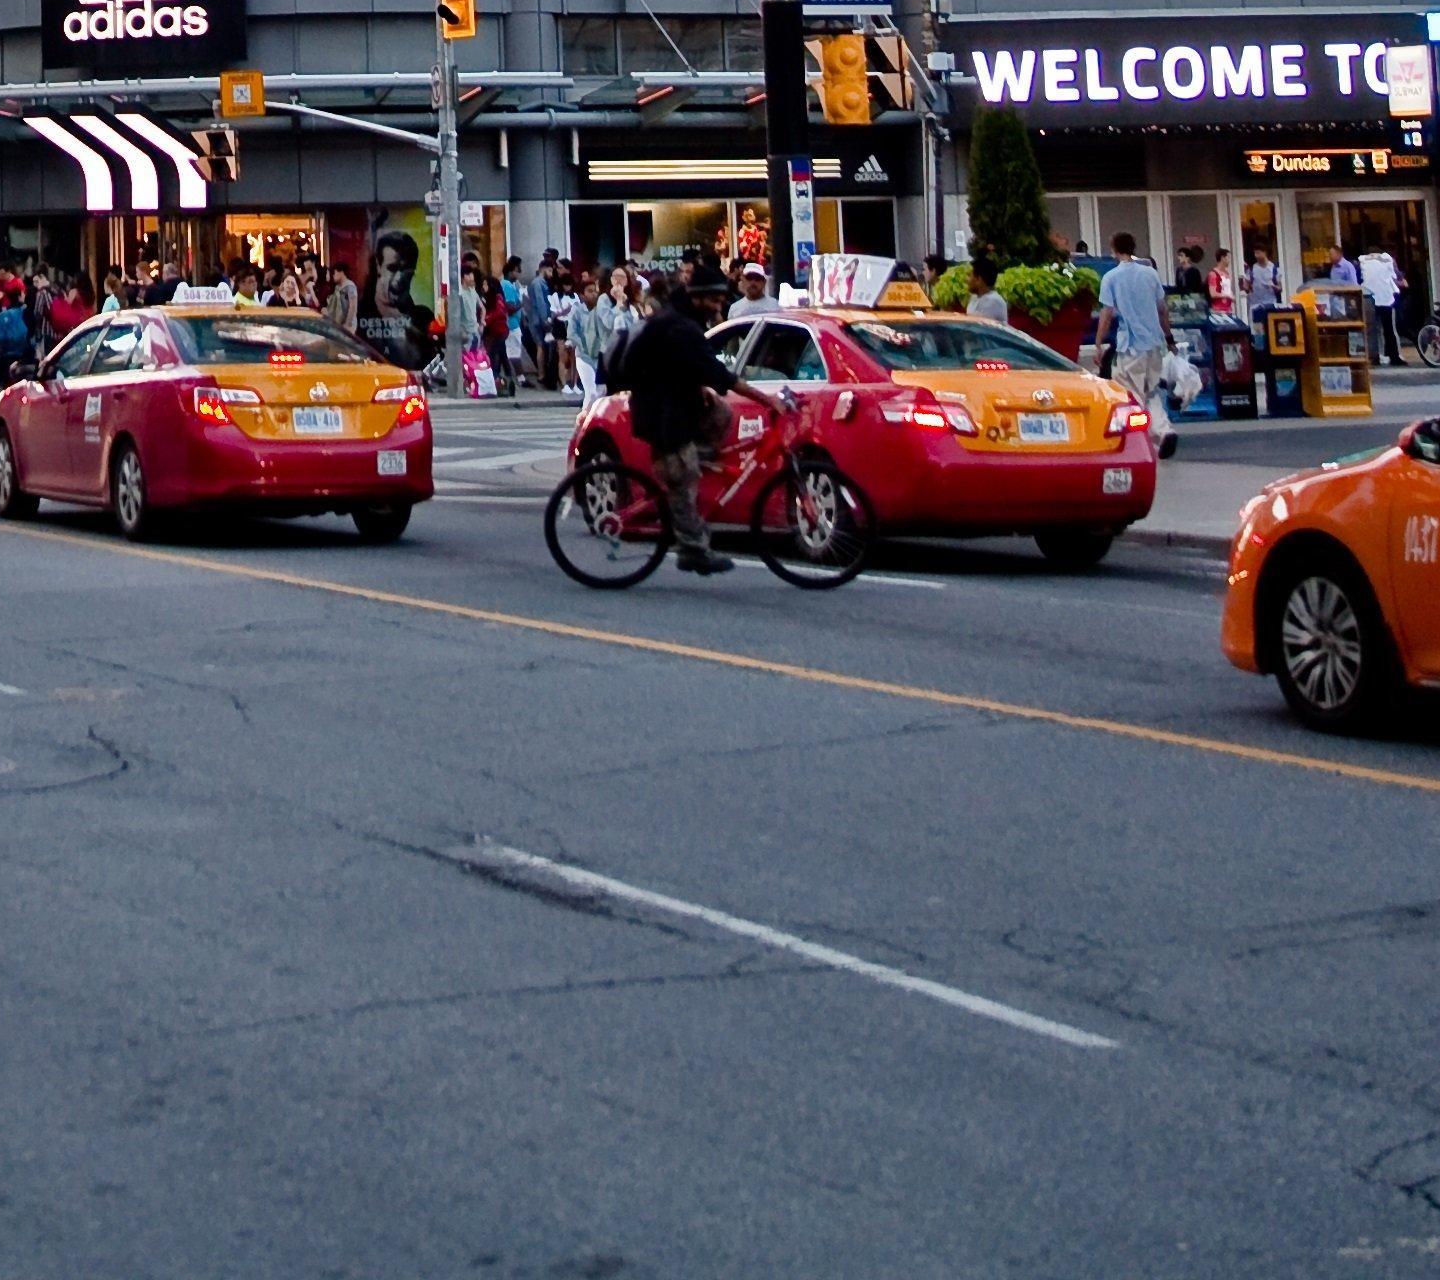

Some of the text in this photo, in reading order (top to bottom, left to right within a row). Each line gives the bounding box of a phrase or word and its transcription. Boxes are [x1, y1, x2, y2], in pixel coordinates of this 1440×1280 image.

[64, 0, 208, 42] adidas
[973, 45, 1306, 102] WELCOME
[1273, 155, 1330, 171] Dundas
[855, 172, 888, 182] adidas
[360, 317, 411, 328] DESTROY
[366, 327, 404, 338] ORDER
